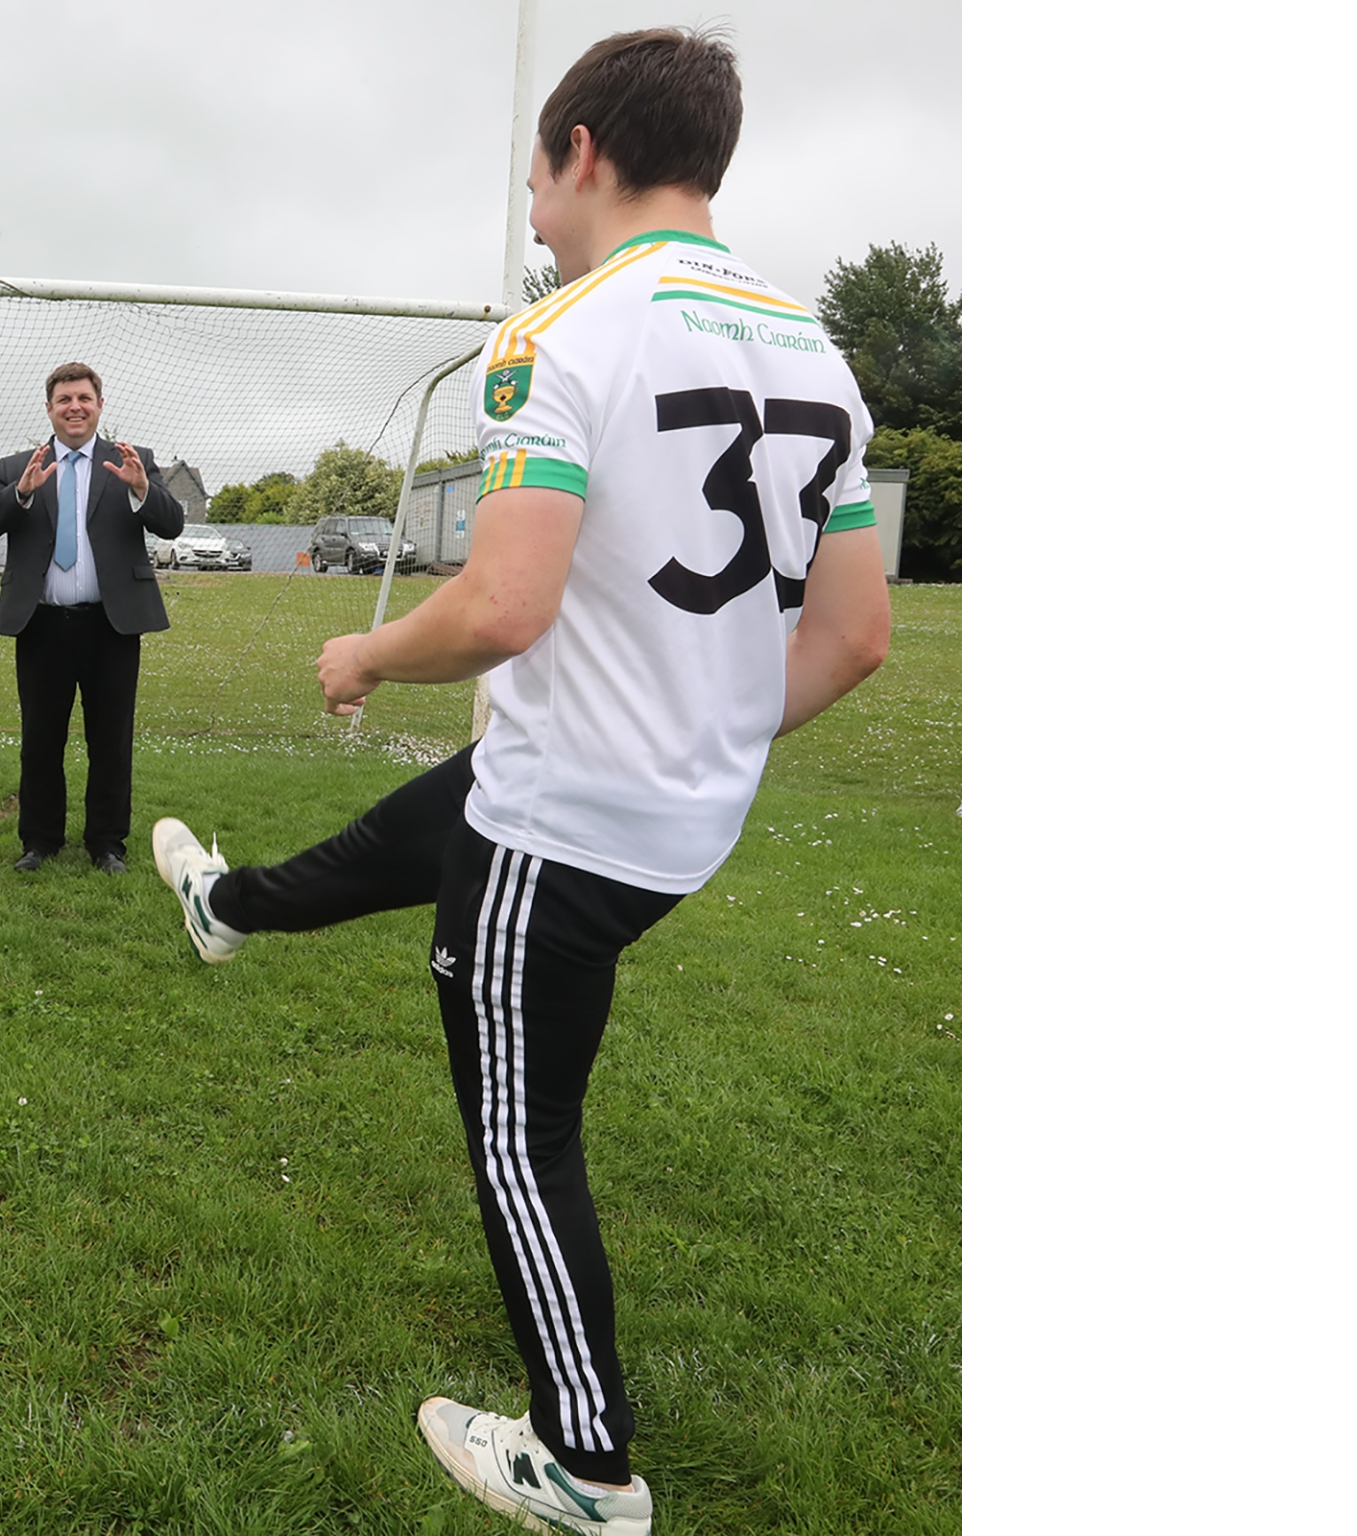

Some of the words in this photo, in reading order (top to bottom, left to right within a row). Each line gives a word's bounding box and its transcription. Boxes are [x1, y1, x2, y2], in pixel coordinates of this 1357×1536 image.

[680, 310, 754, 341] Naomh
[757, 323, 826, 354] Ciaráin
[504, 432, 567, 449] Ciaráin
[647, 386, 852, 616] 33
